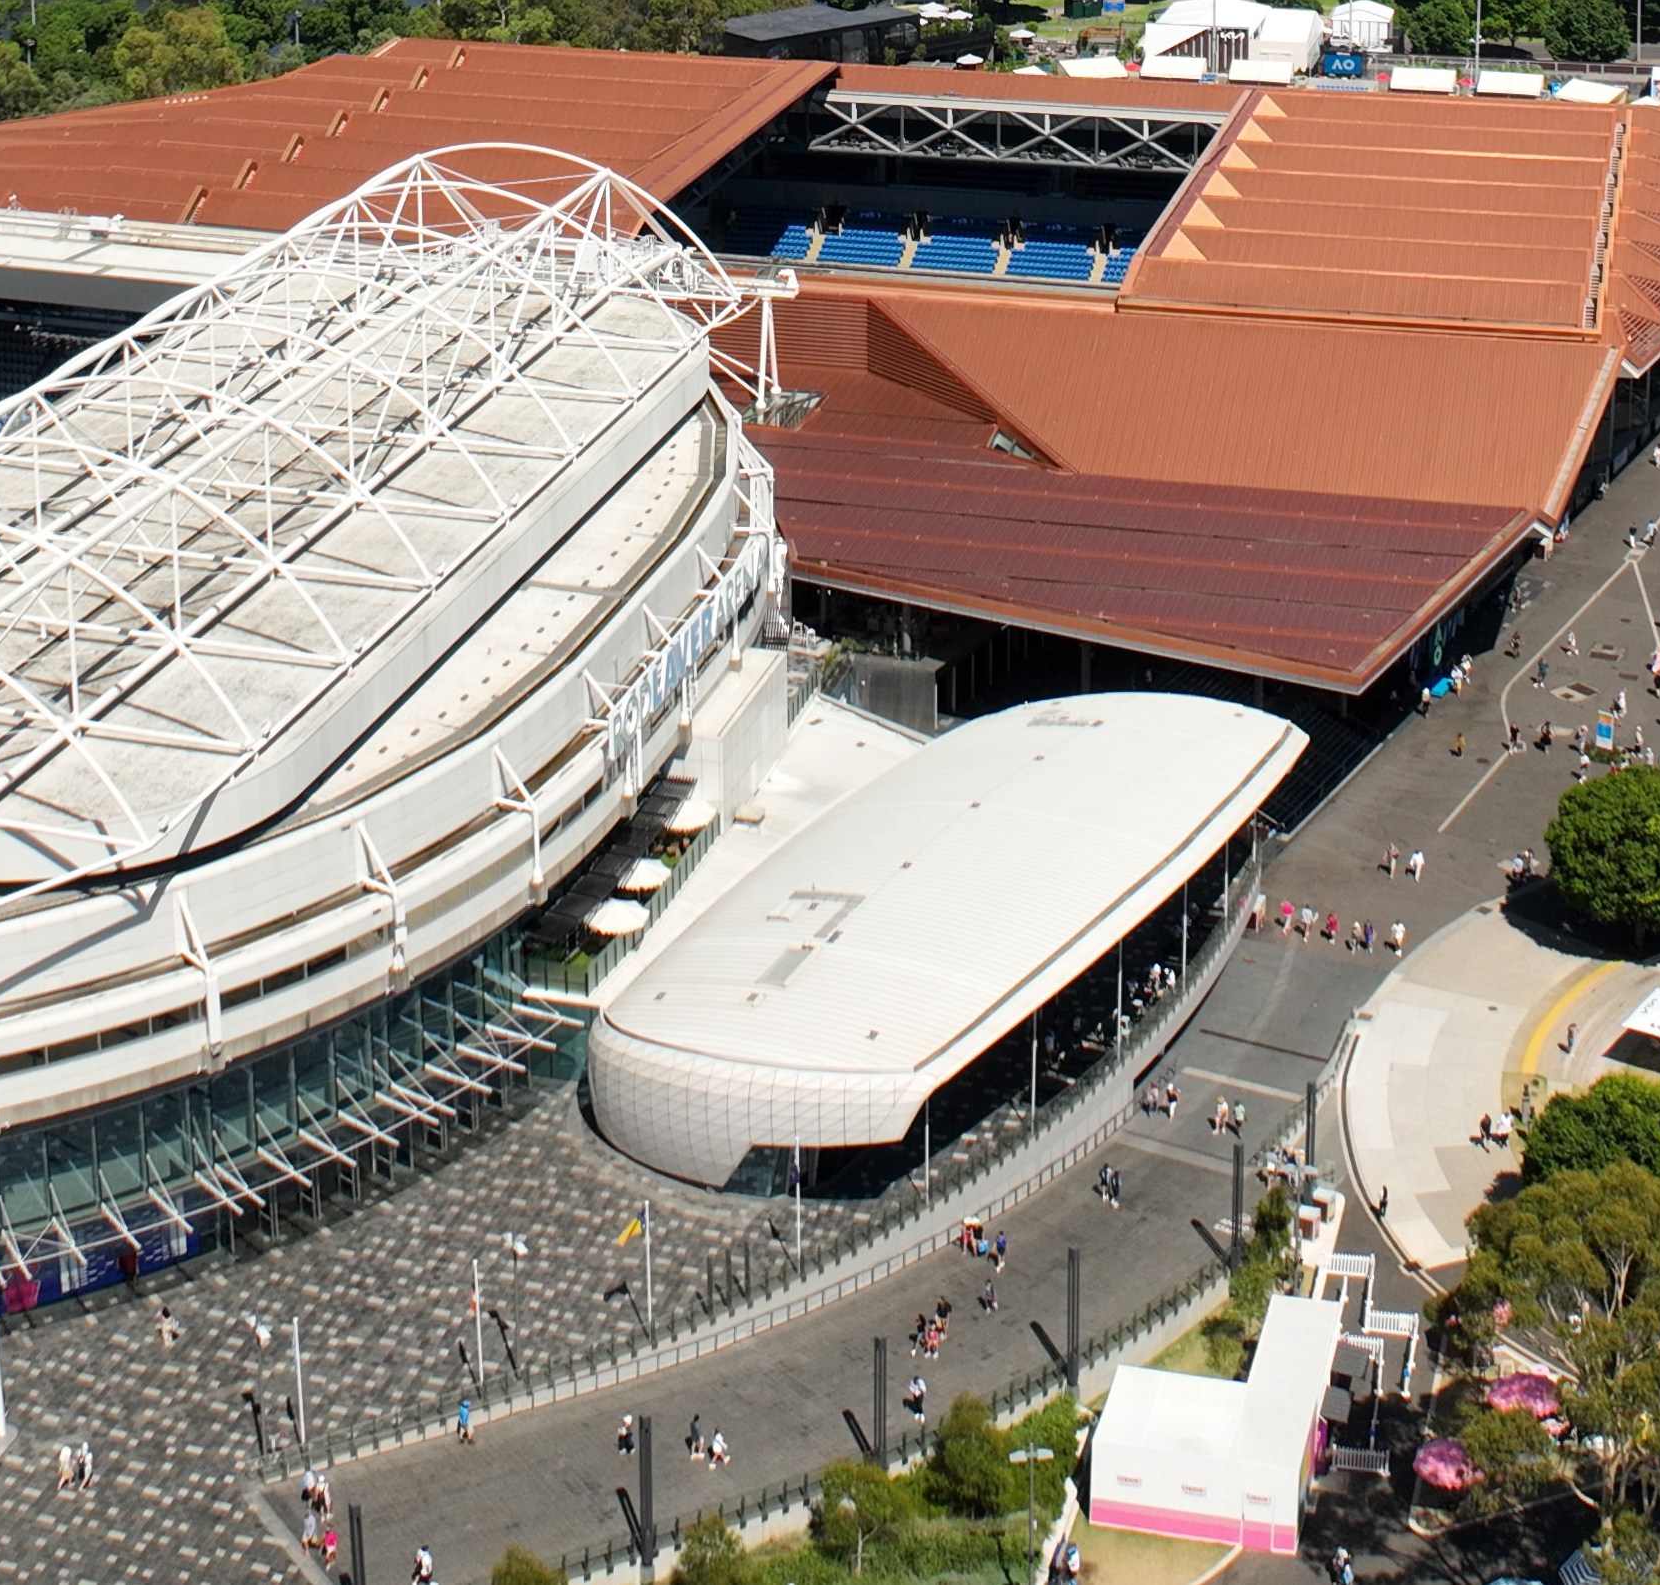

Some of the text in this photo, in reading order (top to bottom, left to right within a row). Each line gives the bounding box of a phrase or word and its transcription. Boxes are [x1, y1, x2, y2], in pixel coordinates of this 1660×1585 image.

[1331, 58, 1356, 71] AO
[608, 539, 769, 762] ROD LAVER ARENA
